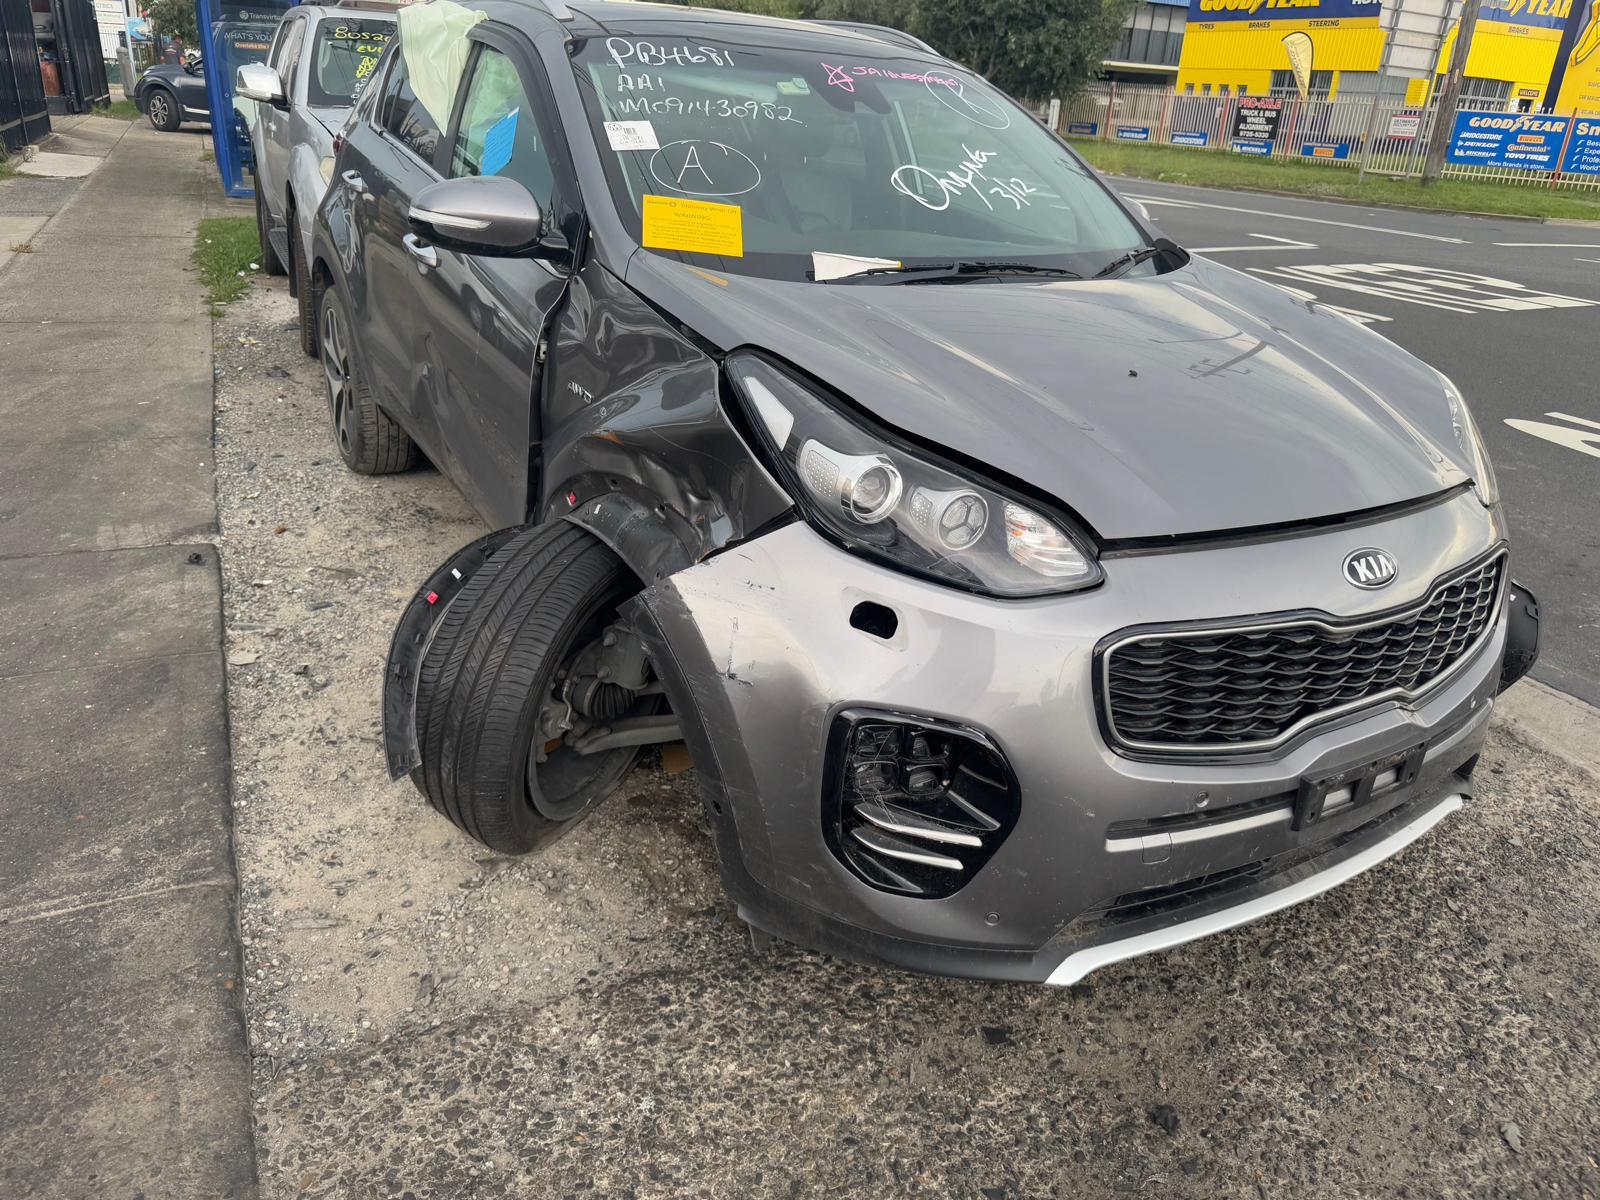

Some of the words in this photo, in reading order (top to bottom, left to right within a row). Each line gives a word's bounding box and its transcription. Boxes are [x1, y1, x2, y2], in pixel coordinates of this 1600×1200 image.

[1240, 109, 1258, 117] TRUCK
[1264, 110, 1277, 118] BUS
[1238, 123, 1273, 131] ALIGNMENT
[1469, 115, 1566, 133] GOODYEAR
[1460, 131, 1503, 140] BRIDGESTONE
[1505, 152, 1525, 160] TOYO
[677, 145, 714, 185] A
[1351, 554, 1395, 582] KIA
